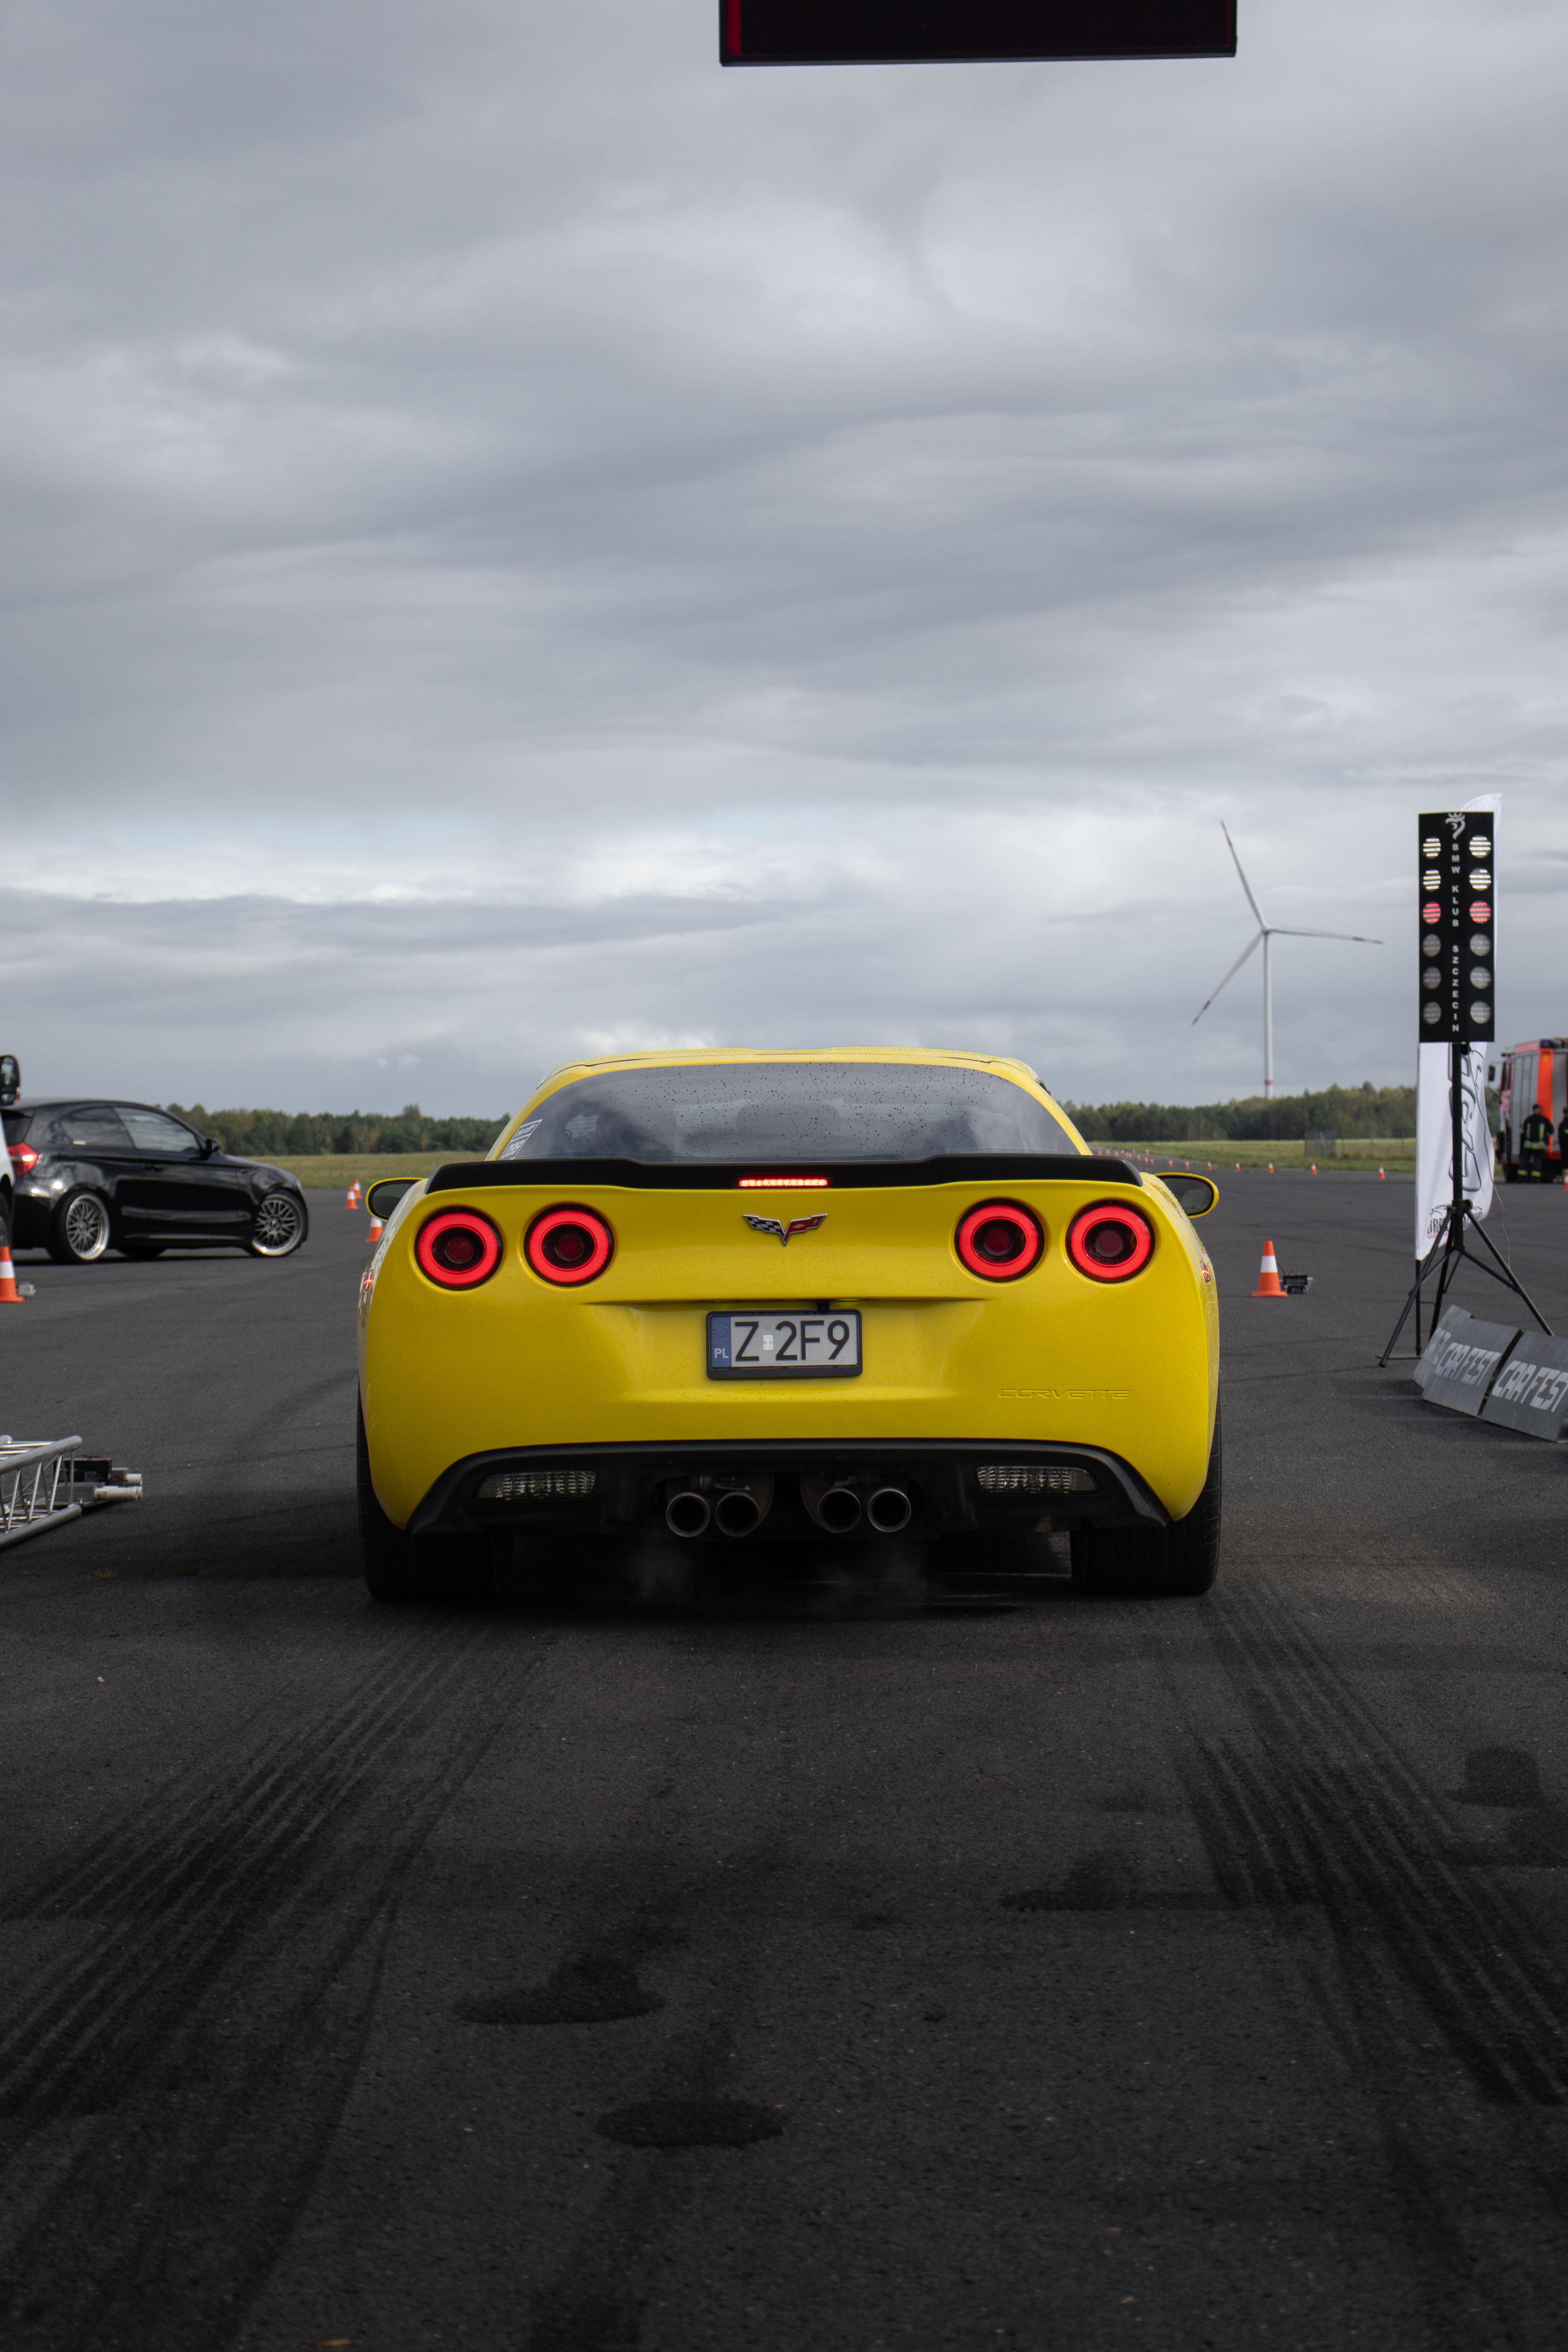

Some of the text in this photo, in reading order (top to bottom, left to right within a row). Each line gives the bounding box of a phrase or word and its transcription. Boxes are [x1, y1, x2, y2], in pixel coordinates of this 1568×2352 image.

[1452, 843, 1460, 874] BMW
[714, 1348, 729, 1359] PL
[735, 1320, 850, 1361] Z 2F9
[1434, 1342, 1471, 1379] CAR
[1454, 1347, 1502, 1386] FEST
[1492, 1360, 1537, 1402] CAR
[998, 1388, 1132, 1399] CORVETTE
